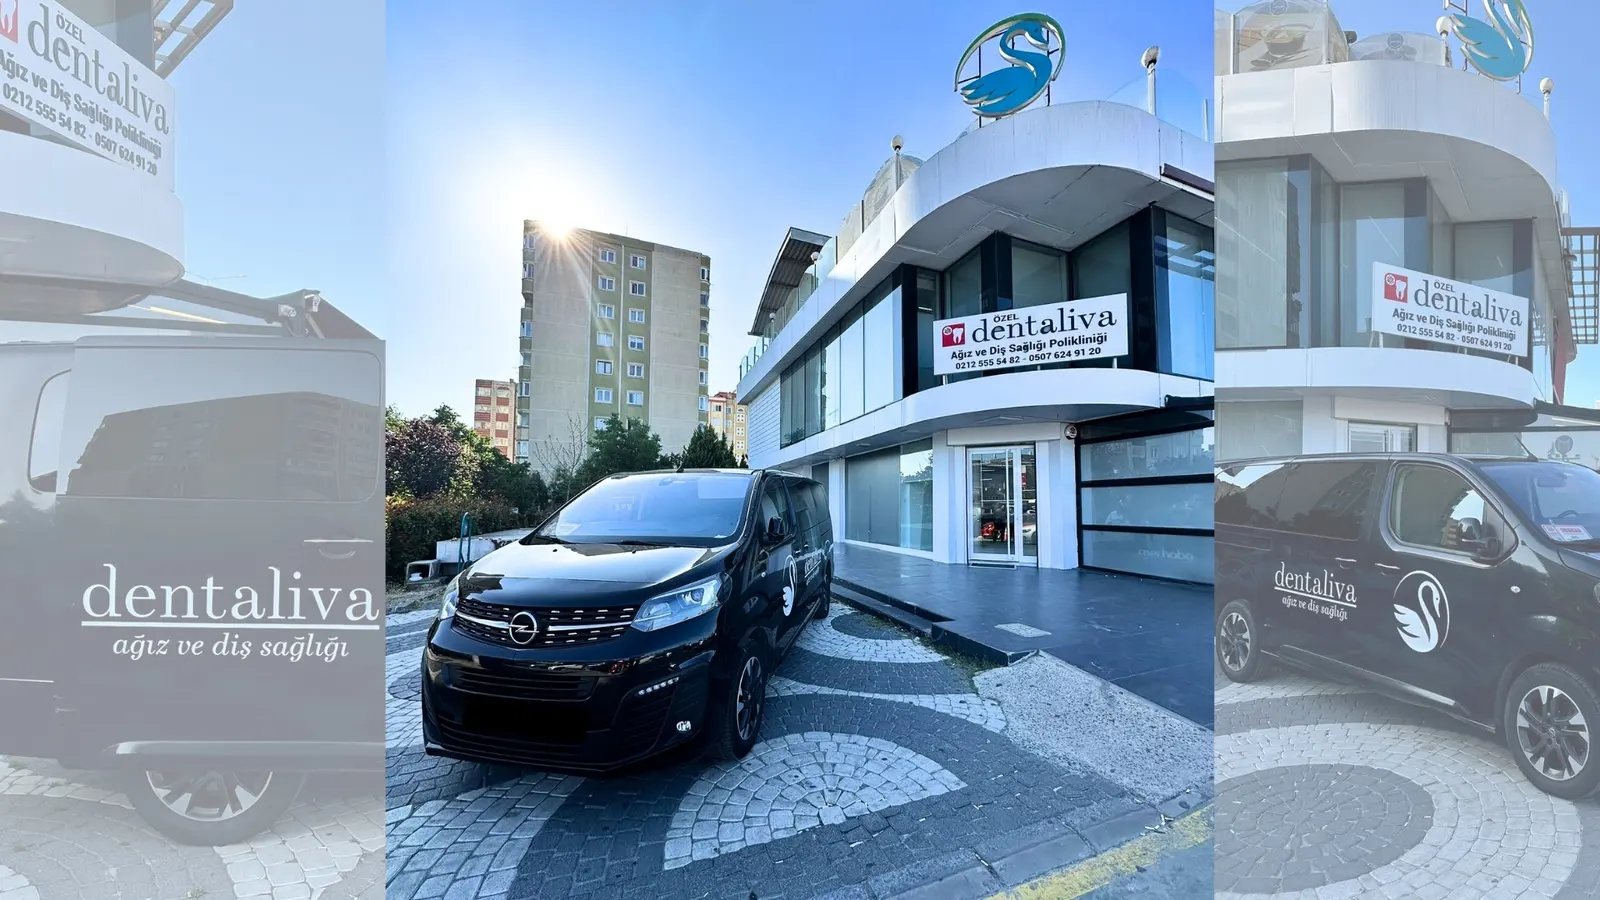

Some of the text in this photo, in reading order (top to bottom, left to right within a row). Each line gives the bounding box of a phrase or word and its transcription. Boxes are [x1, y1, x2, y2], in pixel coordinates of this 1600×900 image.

[56, 10, 86, 45] ÖZEL
[27, 3, 170, 135] dentaliva
[3, 82, 33, 112] 0212
[36, 100, 56, 123] 555
[58, 112, 72, 132] 54
[74, 121, 86, 140] 82
[95, 132, 118, 155] 0507
[119, 146, 135, 164] 624
[136, 154, 146, 170] 91
[32, 72, 48, 92] ve
[51, 78, 72, 110] Diş
[74, 94, 113, 132] Sağlığı
[115, 117, 162, 160] Polikliniği
[1414, 279, 1522, 326] dentaliva
[1434, 279, 1455, 292] ÖZEL
[972, 307, 1117, 343] dentaliva
[993, 313, 1019, 323] ÖZEL
[1392, 308, 1516, 341] Ağız ve Diş Sağlığı Polikliniği
[951, 332, 1108, 360] Ağız ve Diş Sağlığı Polikliniği
[1397, 323, 1417, 334] 0212
[1419, 328, 1433, 338] 555
[1435, 330, 1444, 339] 54
[1446, 332, 1455, 341] 82
[1461, 336, 1478, 345] 0507
[1480, 340, 1492, 348] 624
[1494, 341, 1502, 349] 91
[1503, 342, 1512, 350] 20
[955, 362, 976, 370] 0212
[978, 359, 994, 367] 555
[996, 357, 1007, 366] 54
[1009, 356, 1020, 364] 82
[1029, 353, 1051, 362] 0507
[1054, 350, 1071, 359] 624
[1074, 349, 1085, 357] 91
[1088, 347, 1101, 355] 20
[82, 563, 380, 621] dentaliva
[1275, 561, 1357, 603] dentaliva
[1282, 596, 1348, 622] ağız ve diş sağlığı
[113, 632, 350, 662] ağız ve diş sağlığı
